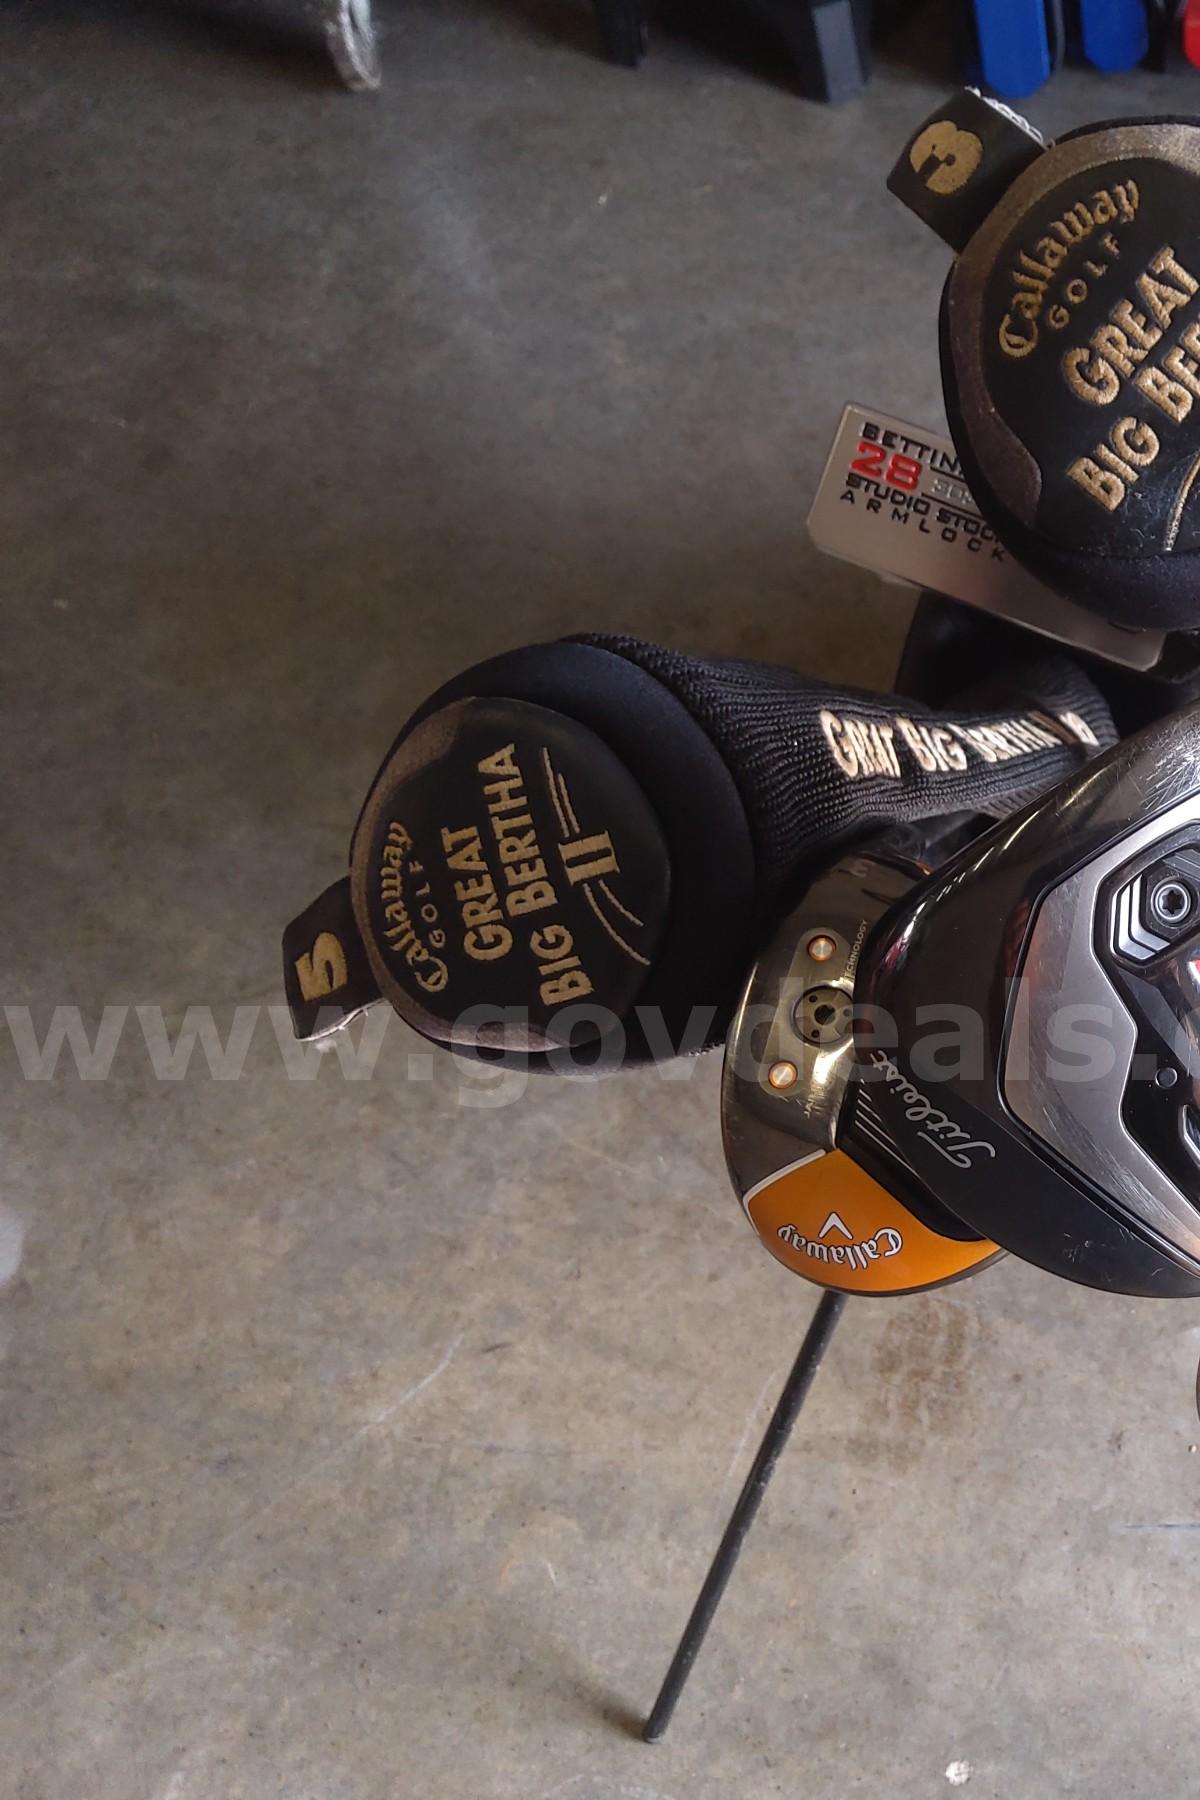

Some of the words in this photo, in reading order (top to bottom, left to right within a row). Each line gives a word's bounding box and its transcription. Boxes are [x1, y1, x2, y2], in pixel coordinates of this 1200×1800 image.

[909, 120, 984, 195] 3
[999, 178, 1140, 358] Callaway
[1046, 236, 1125, 331] GOLF
[1061, 245, 1200, 406] GREAT
[849, 440, 923, 493] 28
[860, 421, 965, 477] BETTIN
[1066, 416, 1160, 513] BIG
[839, 489, 1005, 563] ARMLOCK
[846, 471, 931, 517] STUDIO
[936, 507, 1003, 545] STOC
[476, 743, 560, 920] BERTHA
[381, 820, 450, 993] Callaway
[408, 859, 446, 949] GOLF
[441, 824, 513, 962] GREAT
[295, 930, 345, 1002] 5
[529, 921, 596, 1006] BIG
[870, 1049, 996, 1169] Titleist
[776, 1223, 903, 1271] Callaway
